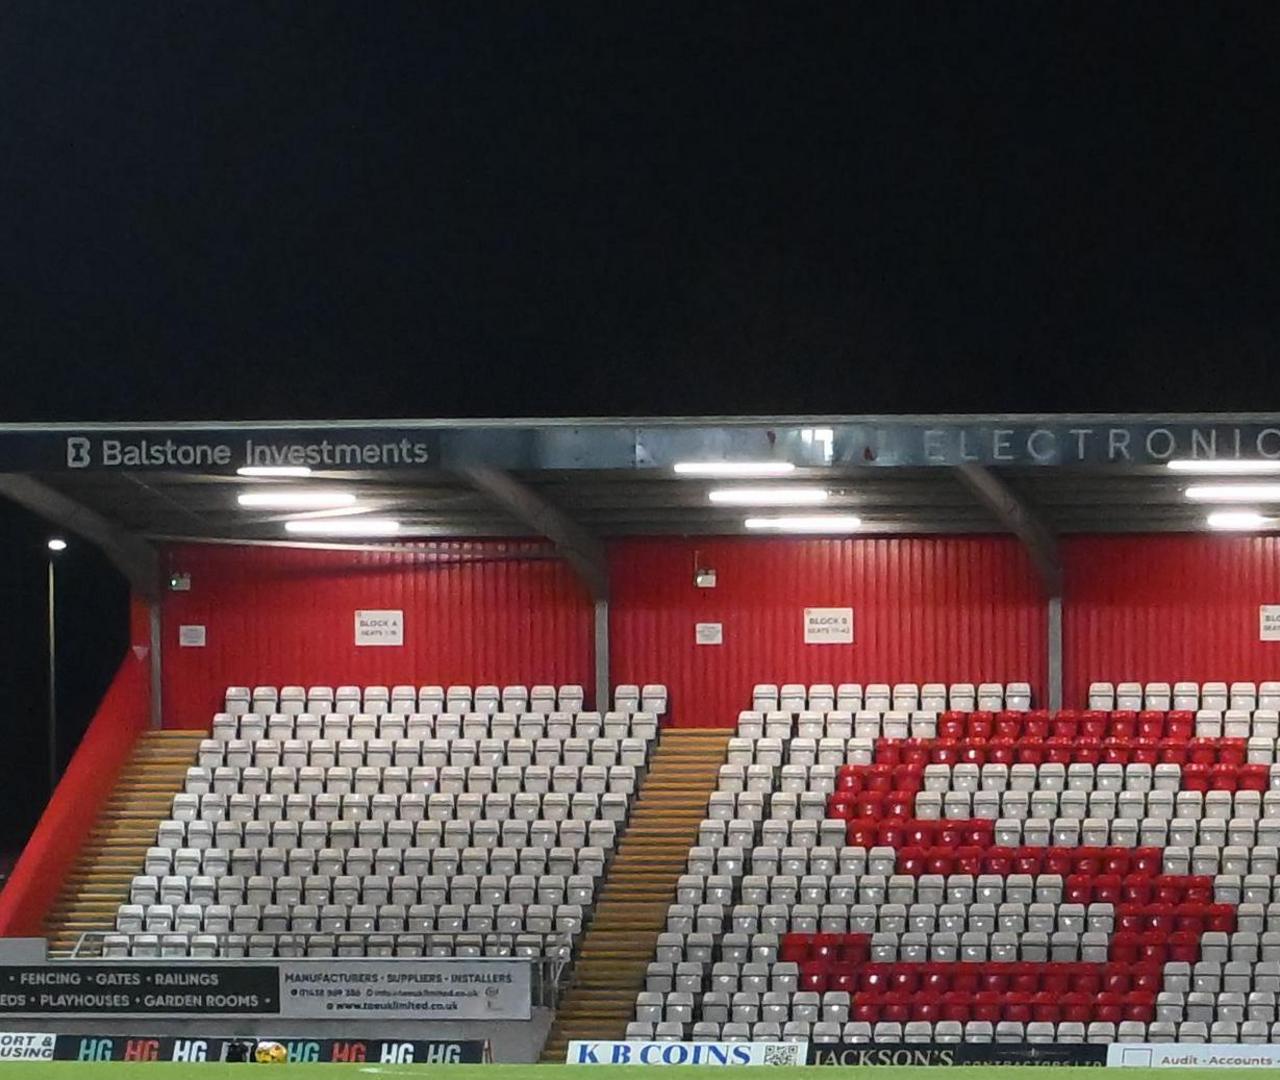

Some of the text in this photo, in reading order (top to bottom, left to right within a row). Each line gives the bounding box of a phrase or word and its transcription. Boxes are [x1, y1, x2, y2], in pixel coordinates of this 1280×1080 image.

[103, 440, 231, 466] Balstone
[246, 438, 429, 466] Investments
[809, 617, 838, 625] BLOCK
[20, 973, 219, 986] FENCING GATES RAILINGS
[285, 973, 512, 983] MANUFACTURERS SUPPLIERS INSTALLERS
[40, 995, 129, 1006] PLAYHOUSES
[144, 995, 202, 1007] GARDEN
[206, 995, 259, 1007] ROOMS
[41, 1036, 53, 1047] &
[78, 1038, 113, 1062] HG
[124, 1039, 159, 1062] HG
[172, 1040, 207, 1063] HG
[287, 1041, 320, 1063] HG
[331, 1042, 367, 1063] HG
[380, 1042, 415, 1064] HG
[427, 1043, 461, 1064] HG
[578, 1044, 750, 1065] K B COINS
[814, 1049, 953, 1066] JACKSON'S
[1161, 1056, 1198, 1065] Audit
[1208, 1056, 1273, 1065] Accounts
